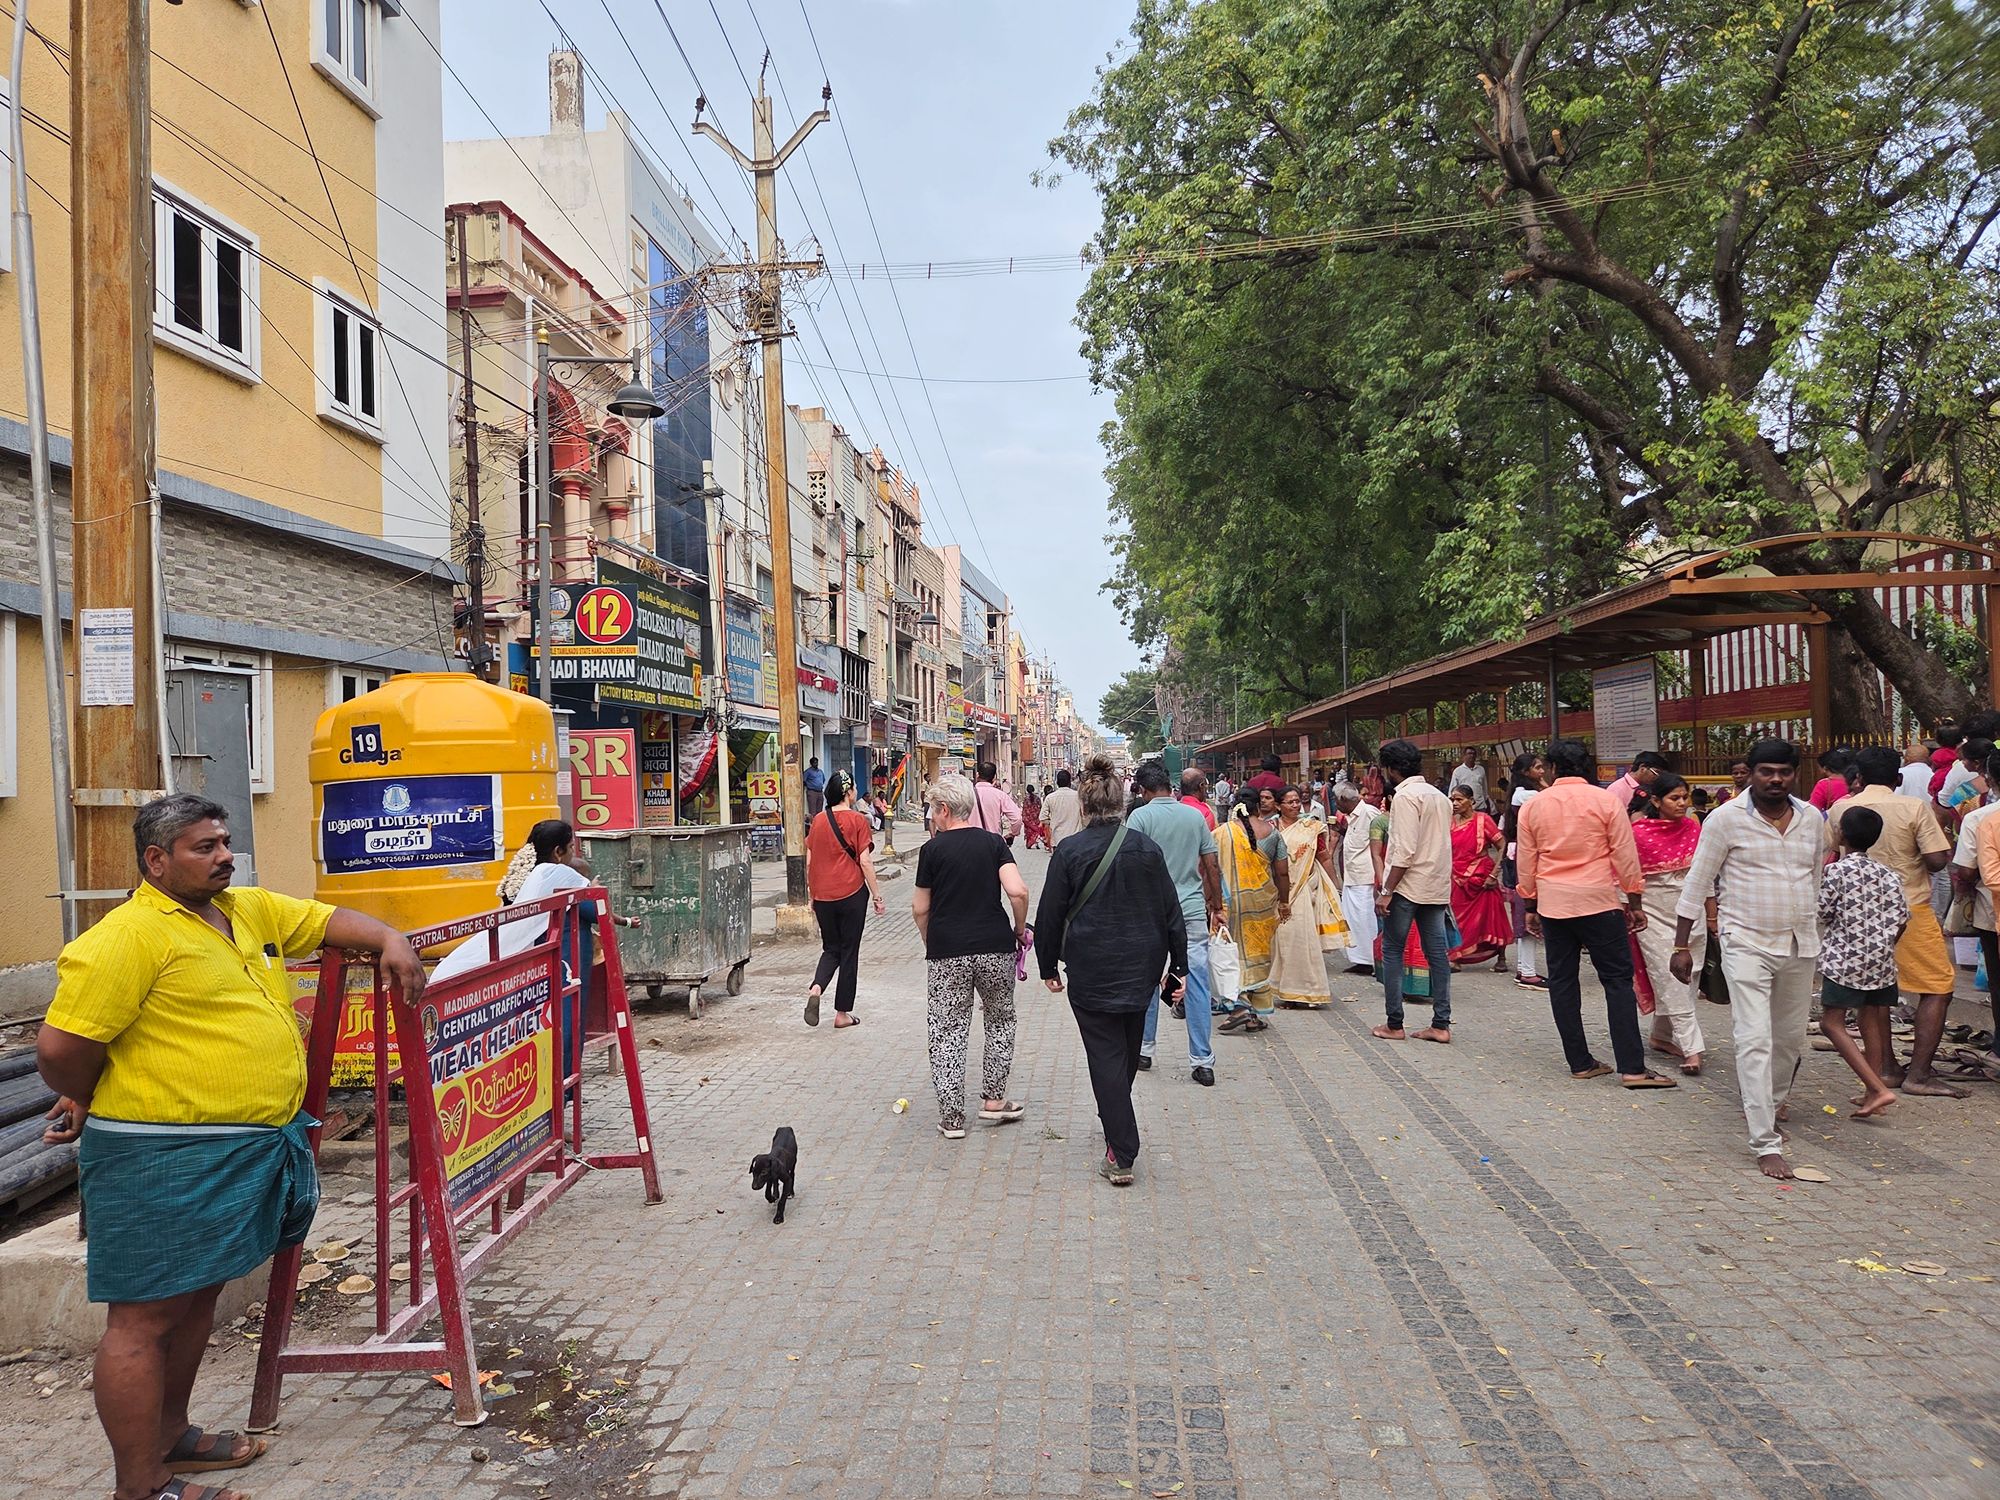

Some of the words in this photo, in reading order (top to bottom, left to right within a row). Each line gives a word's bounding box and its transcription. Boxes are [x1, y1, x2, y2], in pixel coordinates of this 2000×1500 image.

[582, 594, 621, 636] 12
[666, 645, 685, 667] STATE
[730, 631, 760, 664] BHAVAN
[581, 659, 636, 679] BHAVAN
[600, 685, 621, 699] FACTORY
[355, 733, 377, 753] 19
[643, 743, 669, 758] खादी
[339, 748, 402, 766] Gga
[643, 760, 669, 772] भवन
[646, 789, 668, 798] KHADI
[749, 779, 777, 796] 13
[644, 797, 671, 806] BHAVAN
[327, 818, 375, 835] மதுரை
[379, 808, 483, 829] மாநகராட்சி
[370, 830, 427, 850] குடிநீர்
[507, 907, 529, 920] MADURAI
[411, 930, 447, 949] CENTRAL
[449, 920, 474, 938] TRAFFIC
[486, 914, 495, 928] 06
[444, 990, 481, 1016] MADURAI
[482, 982, 500, 1001] CITY
[501, 972, 526, 994] TRAFFIC
[526, 963, 548, 983] POLICE
[443, 1007, 489, 1039] CENTRAL
[490, 993, 522, 1019] TRAFFIC
[522, 980, 549, 1004] POLICE
[429, 1040, 482, 1085] WEAR
[487, 1008, 542, 1057] HELMET
[472, 1049, 533, 1115] Rajmahal
